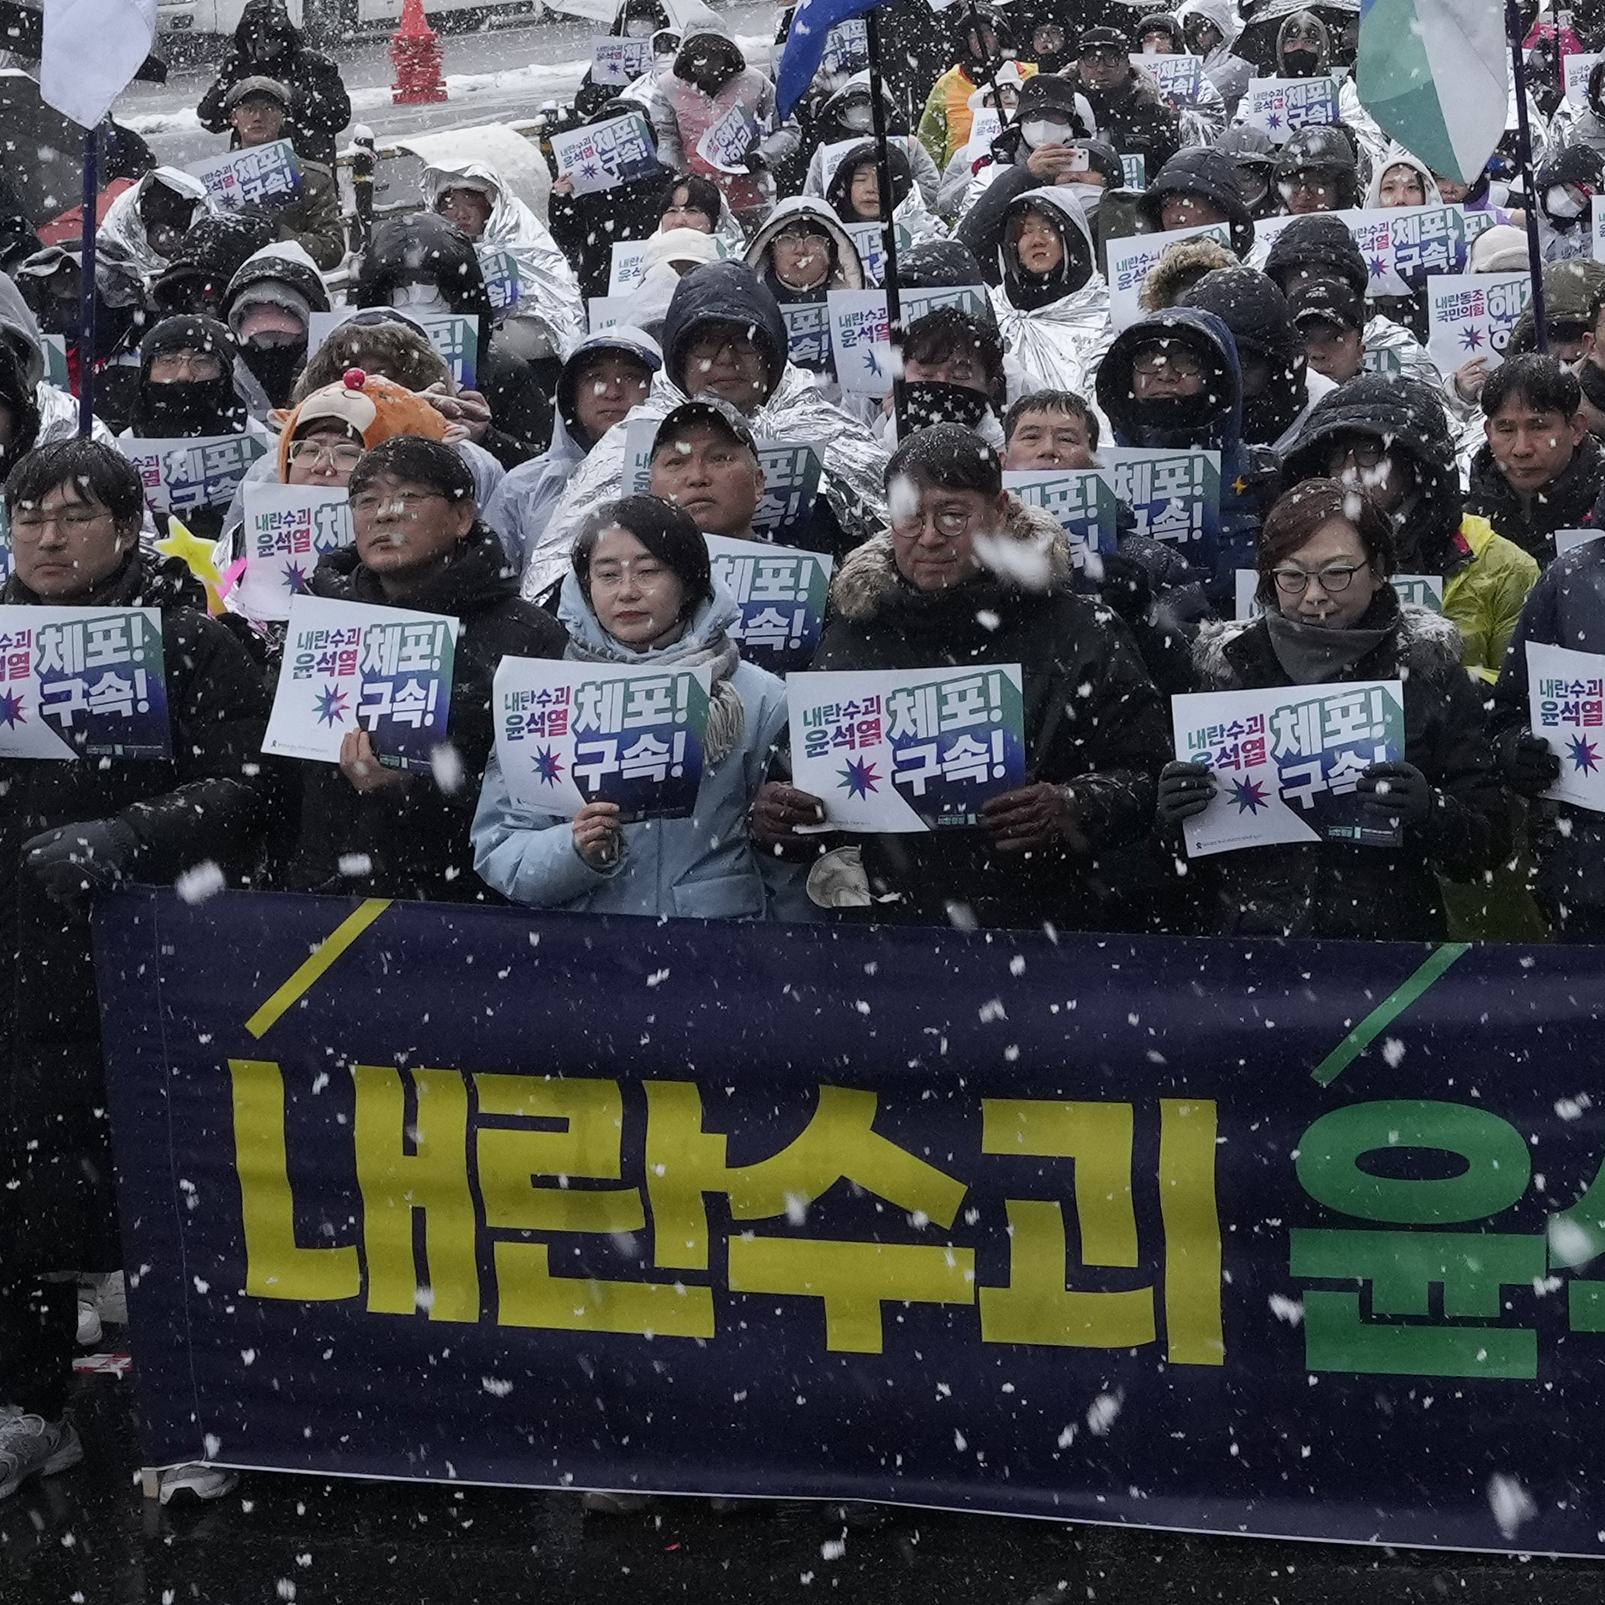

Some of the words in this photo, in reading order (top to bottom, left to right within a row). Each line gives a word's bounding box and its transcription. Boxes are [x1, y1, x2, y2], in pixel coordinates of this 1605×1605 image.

[559, 137, 591, 156] 내란수괴
[593, 117, 641, 149] 체포!
[235, 148, 287, 183] 체포!
[563, 146, 594, 166] 윤석열
[600, 141, 649, 176] 구속!
[1393, 207, 1456, 246] 체포!
[1397, 239, 1458, 278] 구속!
[1435, 291, 1483, 311] 내란동조
[1435, 303, 1486, 324] 국민의힘
[166, 439, 252, 484] 체포!
[1114, 458, 1205, 503] 체포!
[254, 508, 313, 530] 내란수괴
[256, 528, 312, 559] 윤석열
[711, 557, 810, 605] 체포!
[37, 613, 147, 676] 체포!
[297, 626, 361, 653] 내란수괴
[360, 624, 444, 676] 체포!
[291, 649, 358, 680] 윤석열
[41, 669, 149, 727] 구속!
[358, 677, 439, 731] 구속!
[504, 686, 570, 714] 내란수괴
[574, 676, 689, 736] 체포!
[887, 672, 1003, 740] 체포!
[1539, 678, 1602, 699] 내란수괴
[504, 708, 570, 741] 윤석열
[802, 696, 882, 729] 내란수괴
[1269, 688, 1385, 759] 체포!
[1540, 699, 1602, 728] 윤석열
[803, 725, 884, 759] 윤석열
[1189, 714, 1266, 750] 내란수괴
[573, 729, 686, 792] 구속!
[892, 733, 1005, 796] 구속!
[230, 1061, 1223, 1367] 내란수괴
